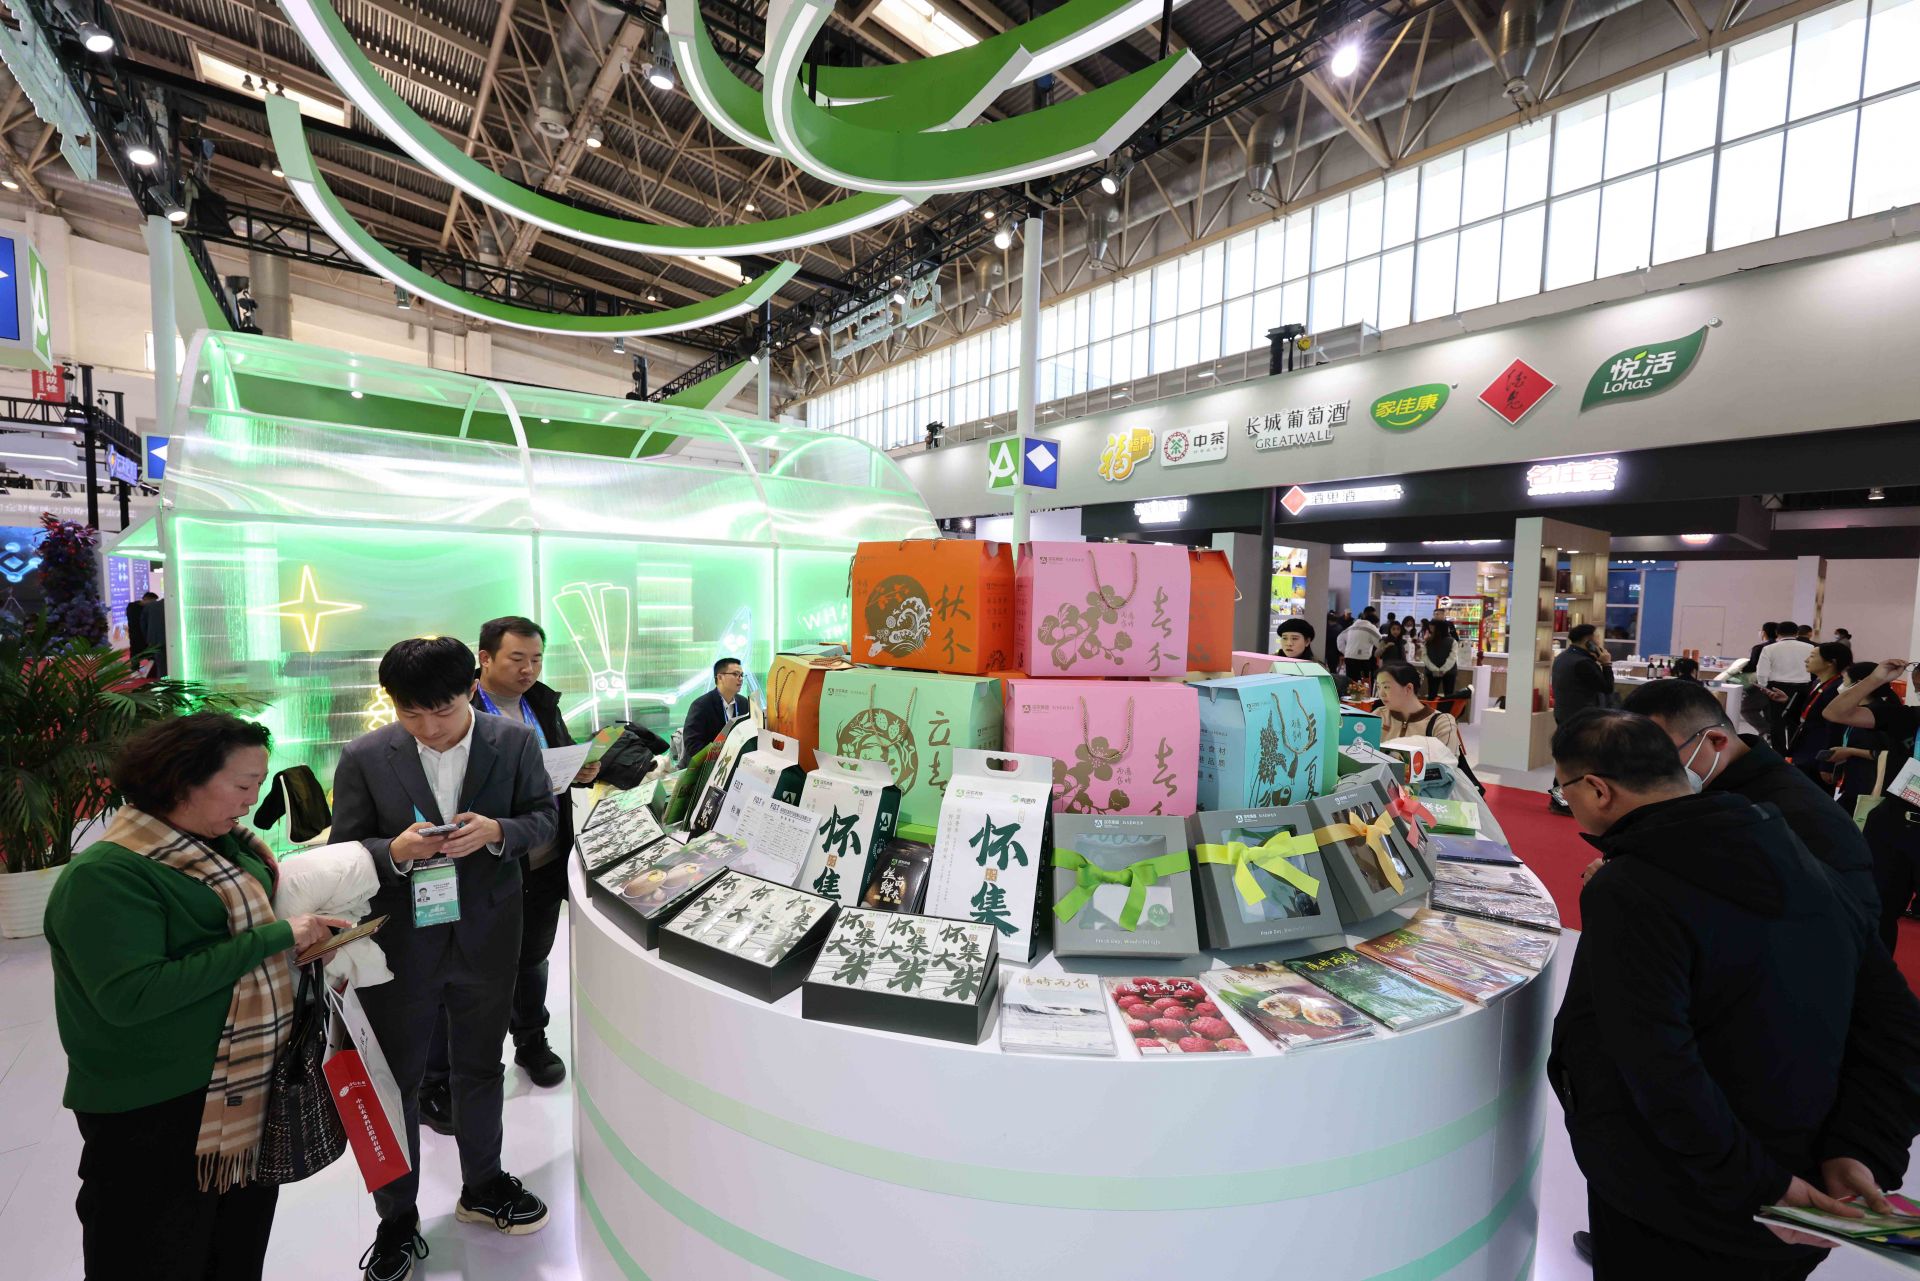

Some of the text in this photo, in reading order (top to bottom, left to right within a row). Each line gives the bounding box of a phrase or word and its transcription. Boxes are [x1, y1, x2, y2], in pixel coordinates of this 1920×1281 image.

[1610, 351, 1677, 381] 悦活
[1602, 377, 1653, 394] Lohas
[1246, 403, 1347, 435] 长城葡萄酒
[1375, 394, 1439, 418] 家佳康
[1193, 431, 1225, 447] 中茶
[1255, 429, 1333, 449] GREATWALL
[968, 813, 1029, 938] 怀集
[838, 911, 878, 948] 怀集
[888, 917, 932, 955] 怀集
[939, 924, 985, 963] 怀集
